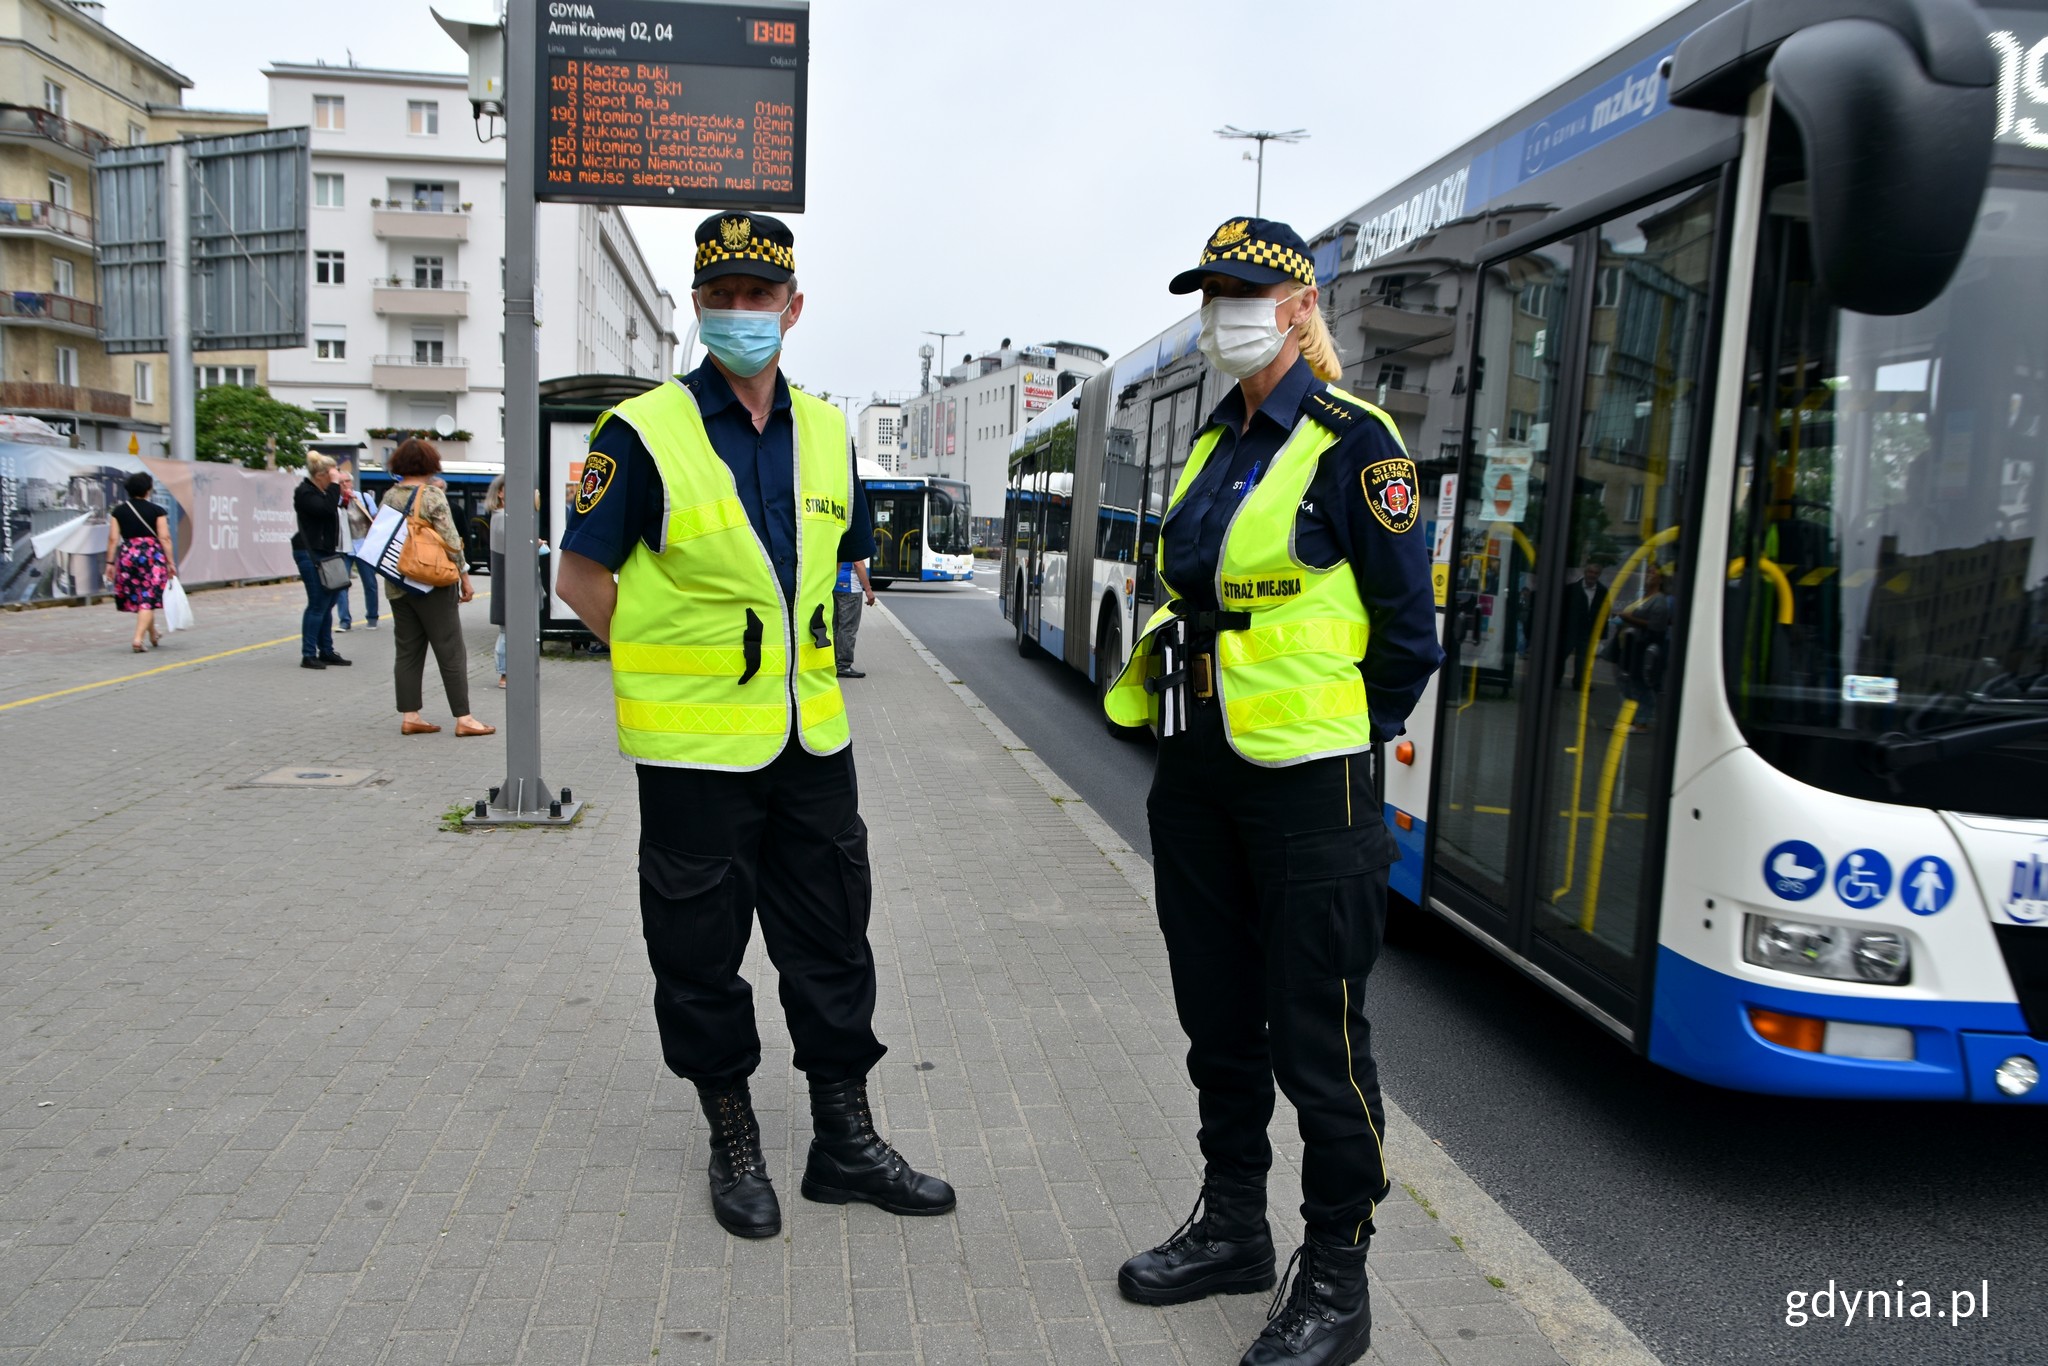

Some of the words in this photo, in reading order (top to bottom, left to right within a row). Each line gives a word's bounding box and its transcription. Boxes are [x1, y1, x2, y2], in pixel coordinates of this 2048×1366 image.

[548, 2, 595, 19] GDYNIA
[548, 21, 577, 36] Armii
[580, 22, 626, 42] Krajowej
[630, 21, 651, 43] 02,
[654, 23, 673, 41] 04
[753, 20, 795, 44] 13:09
[547, 43, 566, 54] Linia
[583, 46, 617, 56] Kierunek
[567, 61, 578, 76] R
[583, 62, 631, 78] Kacze
[637, 64, 669, 80] Buki
[770, 56, 797, 67] Odjazd
[551, 75, 578, 92] 109
[583, 77, 647, 95] Redłowo
[653, 80, 682, 96] SKM
[567, 91, 578, 107] S
[583, 91, 628, 109] Sopot
[636, 95, 670, 110] Reja
[755, 101, 793, 117] 01min
[1590, 73, 1661, 133] mzkzg
[550, 106, 577, 121] 190
[582, 107, 643, 125] Witomino
[650, 110, 745, 130] Leśniczówka
[753, 116, 793, 132] 02min
[567, 121, 577, 137] Z
[582, 123, 638, 140] Żukowo
[697, 128, 737, 144] Gminy
[753, 131, 793, 147] 02min
[550, 136, 577, 152] 150
[582, 138, 643, 156] Witomino
[649, 140, 744, 160] Leśniczówka
[752, 146, 792, 162] 02min
[550, 152, 577, 168] 140
[582, 153, 641, 170] Wiczlino
[648, 155, 722, 174] Niemotowo
[752, 161, 792, 177] 03min
[579, 168, 625, 185] miejsc
[725, 175, 756, 190] musi
[1371, 471, 1412, 485] MIEJSKA
[1372, 462, 1409, 475] STRAŻ
[805, 496, 829, 514] STRAŻ
[1372, 499, 1392, 526] GDYNIA
[1393, 519, 1410, 529] CITY
[1408, 494, 1417, 519] GUARD
[1224, 579, 1254, 600] STRAŻ
[1256, 578, 1302, 599] MIEJSKA
